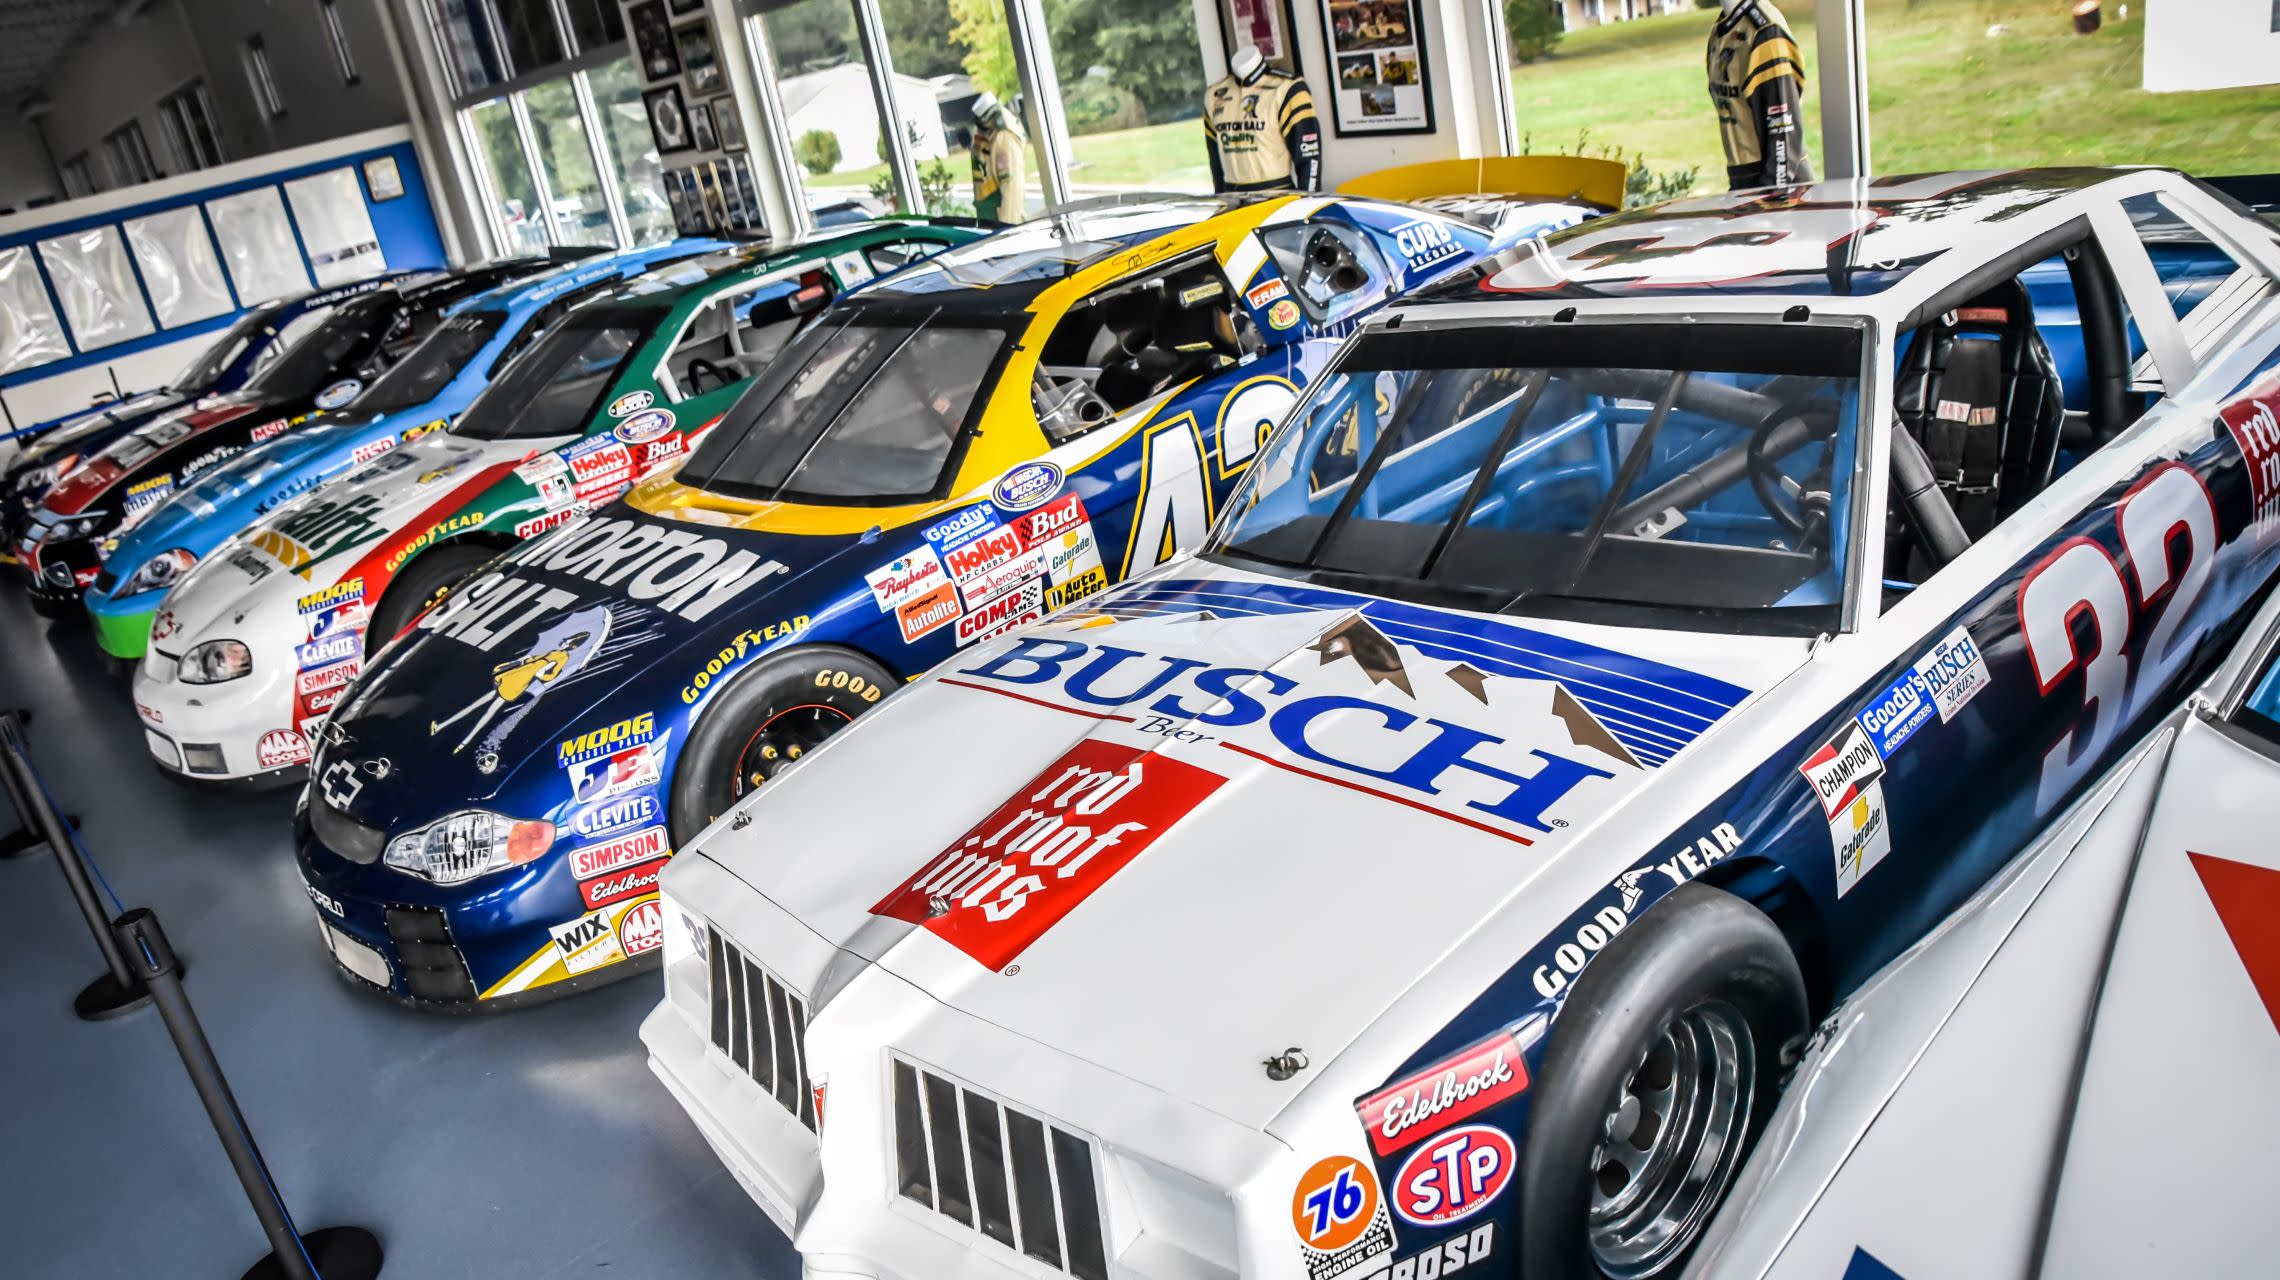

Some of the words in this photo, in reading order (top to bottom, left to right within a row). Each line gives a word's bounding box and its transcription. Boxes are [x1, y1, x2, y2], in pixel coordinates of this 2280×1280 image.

[1397, 221, 1452, 258] CURB
[1253, 285, 1286, 306] FRAM
[255, 421, 287, 441] MSD
[648, 433, 683, 460] Bud
[2240, 399, 2280, 459] red
[572, 448, 628, 475] Holley
[1013, 466, 1043, 484] NASCAR
[2261, 452, 2280, 497] ro
[1011, 473, 1050, 499] BUSCH
[519, 509, 572, 539] COMP
[926, 502, 993, 542] Goody's
[941, 532, 970, 553] HEADACHE
[968, 520, 996, 542] POWDERS
[1028, 532, 1051, 549] POLE
[1054, 518, 1083, 537] AWARD
[1030, 496, 1079, 539] Bud
[385, 511, 485, 572] GOODYEAR
[949, 534, 1018, 577] Holley
[1052, 537, 1090, 570] Gatorade
[507, 517, 783, 622] MORTON
[873, 561, 939, 600] Raybestos
[960, 573, 971, 584] HP
[974, 556, 1004, 575] CARBS
[985, 558, 1037, 590] Aeroquip
[1066, 572, 1097, 593] Auto
[299, 578, 364, 609] MOOG
[418, 572, 579, 652] SALT
[1064, 580, 1105, 605] Meter
[906, 600, 957, 635] Autolite
[960, 592, 1022, 639] COMP
[1004, 600, 1034, 619] CAMS
[302, 637, 355, 664] CLEVITE
[1934, 642, 1949, 657] NASCAR
[2017, 459, 2219, 818] 32
[304, 663, 359, 691] SIMPSON
[681, 615, 811, 704] GOODYEAR
[1923, 636, 1978, 695] BUSCH
[815, 669, 881, 702] GOOD
[1862, 674, 1926, 734] Goody's
[1946, 670, 1975, 706] SERIES
[260, 731, 307, 757] MAC
[559, 711, 654, 760] MOOG
[958, 637, 1615, 834] BUSCH
[1137, 714, 1215, 745] Beer
[1883, 723, 1910, 752] HEADACHE
[1908, 703, 1933, 728] POWDERS
[262, 749, 309, 768] TOOLS
[563, 743, 611, 766] CHASSIS
[619, 729, 654, 749] PARTS
[578, 745, 651, 801] JE
[1031, 762, 1143, 815] red
[1818, 740, 1874, 798] CHAMPION
[576, 796, 652, 834] CLEVITE
[579, 832, 660, 873] SIMPSON
[982, 808, 1149, 879] roof
[1840, 806, 1881, 869] Gatorade
[556, 913, 610, 953] WIX
[625, 903, 662, 941] MA
[1382, 1051, 1514, 1138] Edelbrock
[1409, 1136, 1499, 1215] STP
[1303, 1163, 1366, 1242] 76
[1432, 1212, 1446, 1222] OIL
[1449, 1194, 1488, 1218] TREATMENT
[1312, 1257, 1331, 1275] HIGH
[1332, 1232, 1387, 1265] PERFORMANCE
[1314, 1251, 1364, 1280] ENGINE
[1366, 1240, 1390, 1256] OIL
[1368, 1222, 1493, 1280] ROSO
